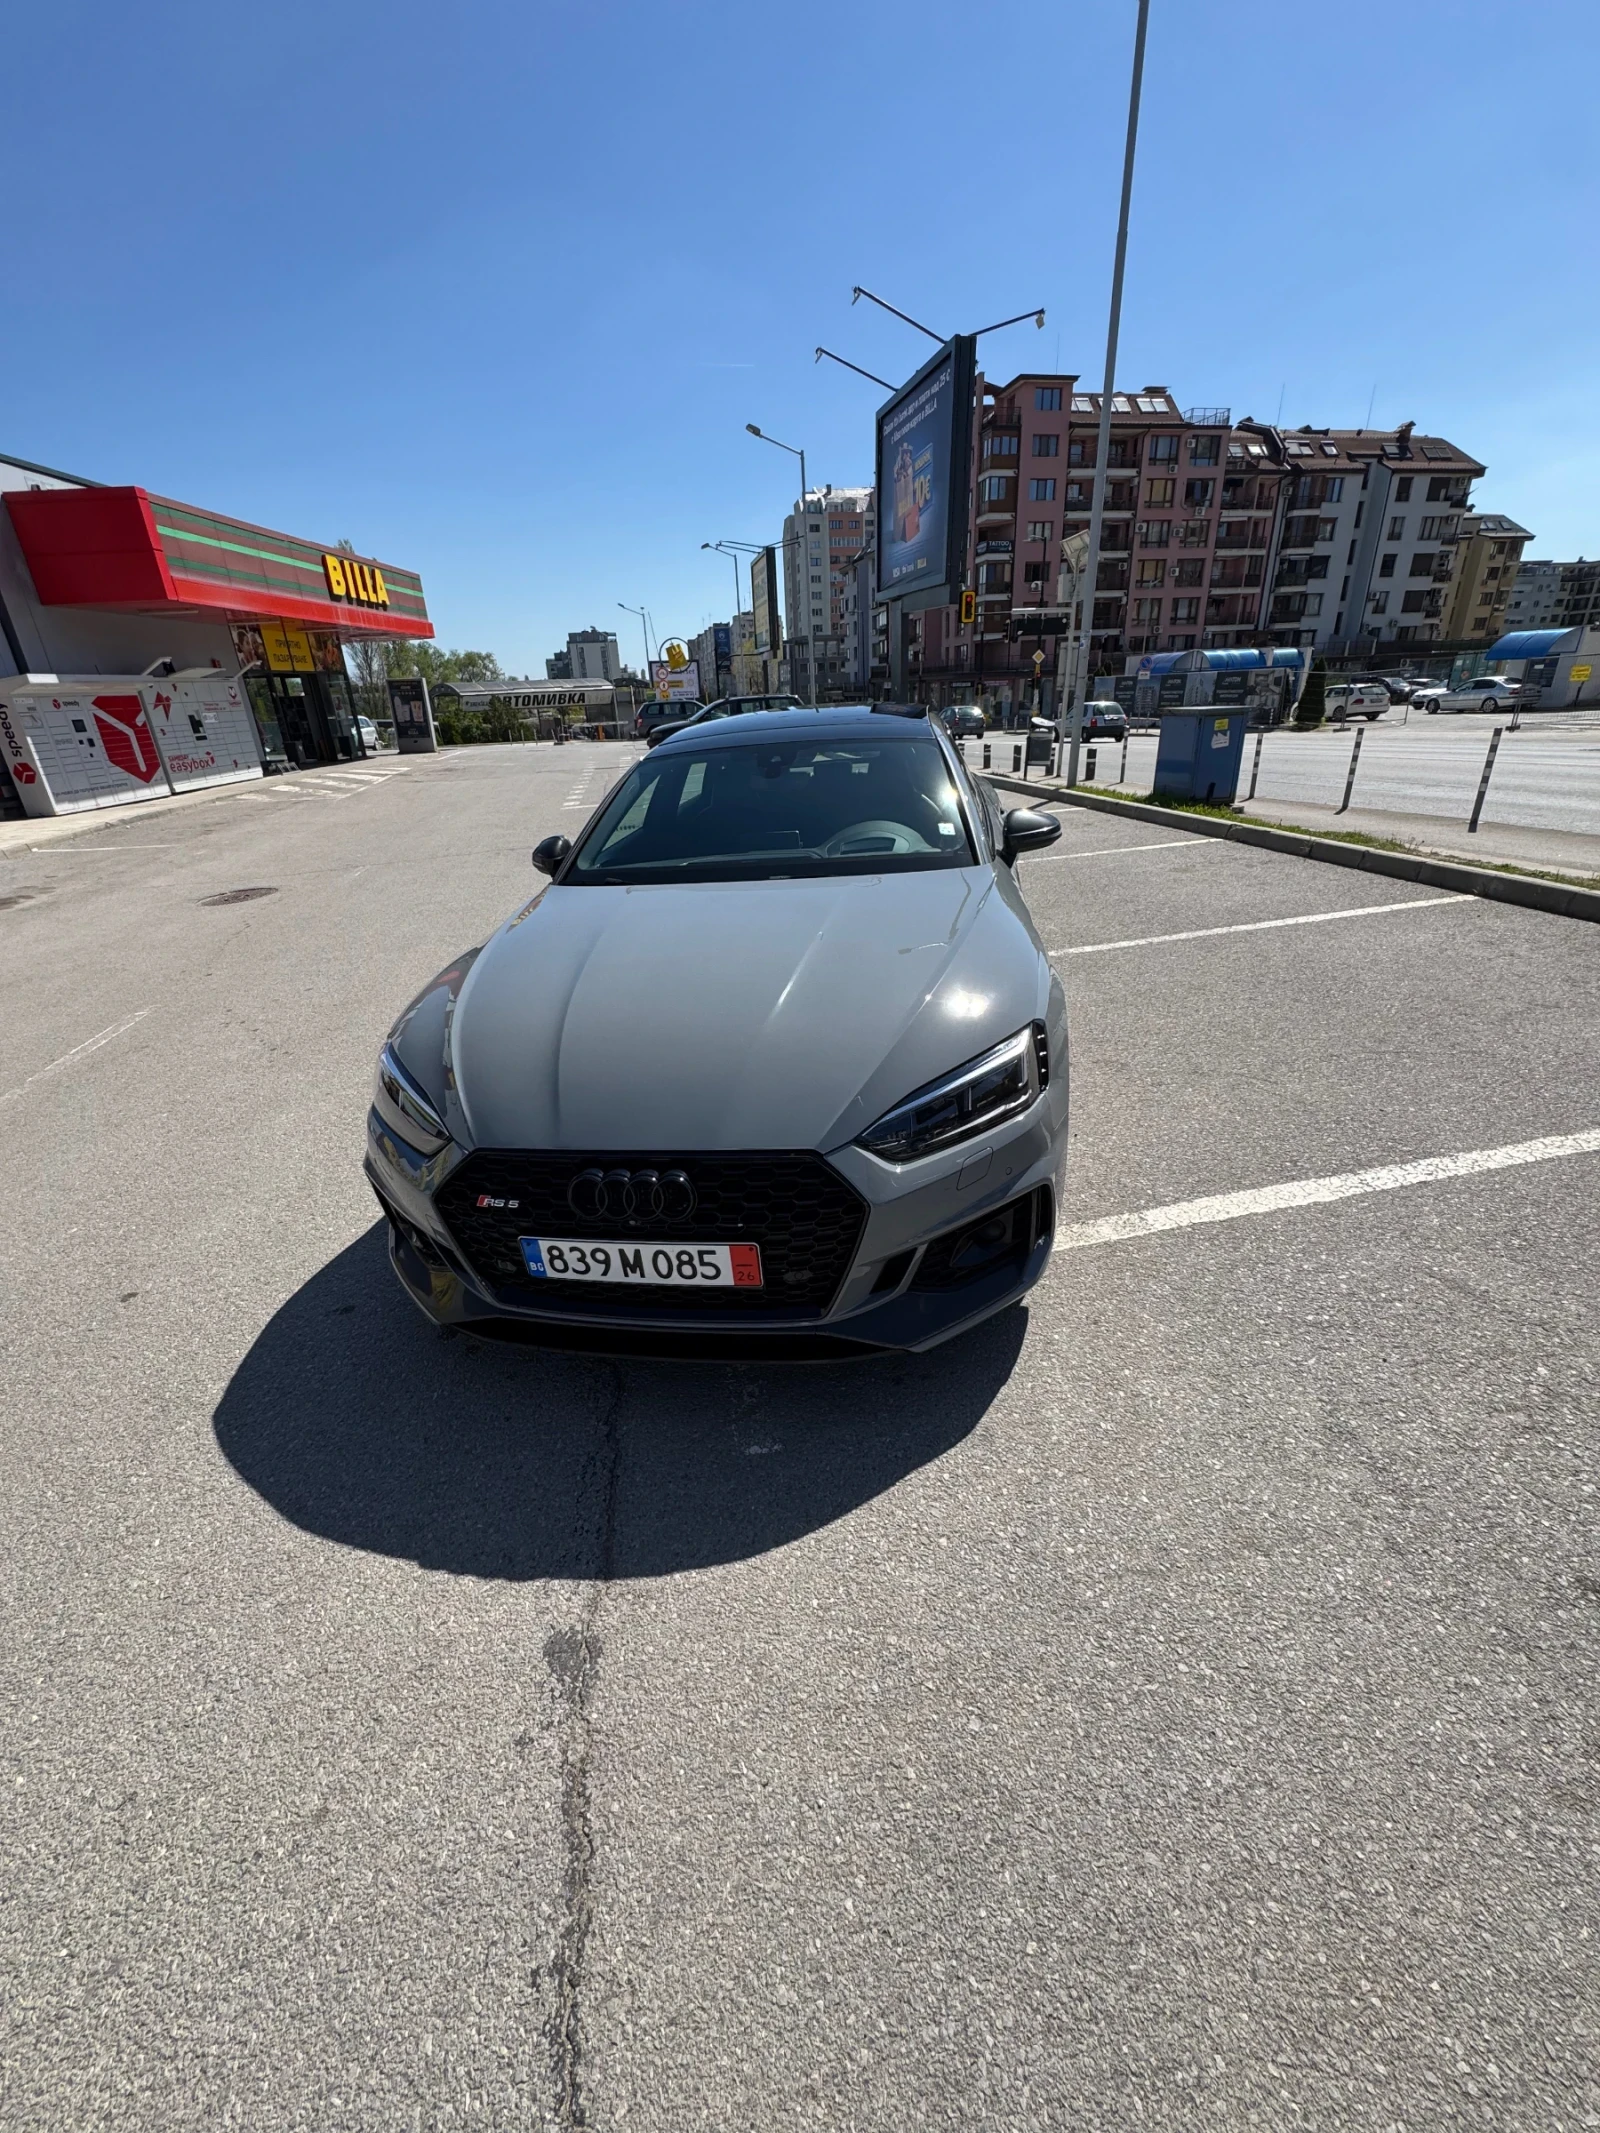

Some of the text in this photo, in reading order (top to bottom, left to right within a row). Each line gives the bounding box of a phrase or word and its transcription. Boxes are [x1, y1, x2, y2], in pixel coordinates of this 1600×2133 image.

[325, 554, 390, 606] BILLA
[500, 692, 586, 708] ВТОМИВКА
[170, 758, 211, 773] easybox
[530, 1260, 544, 1272] BG
[546, 1245, 721, 1280] 839 M 085
[738, 1271, 755, 1281] 26
